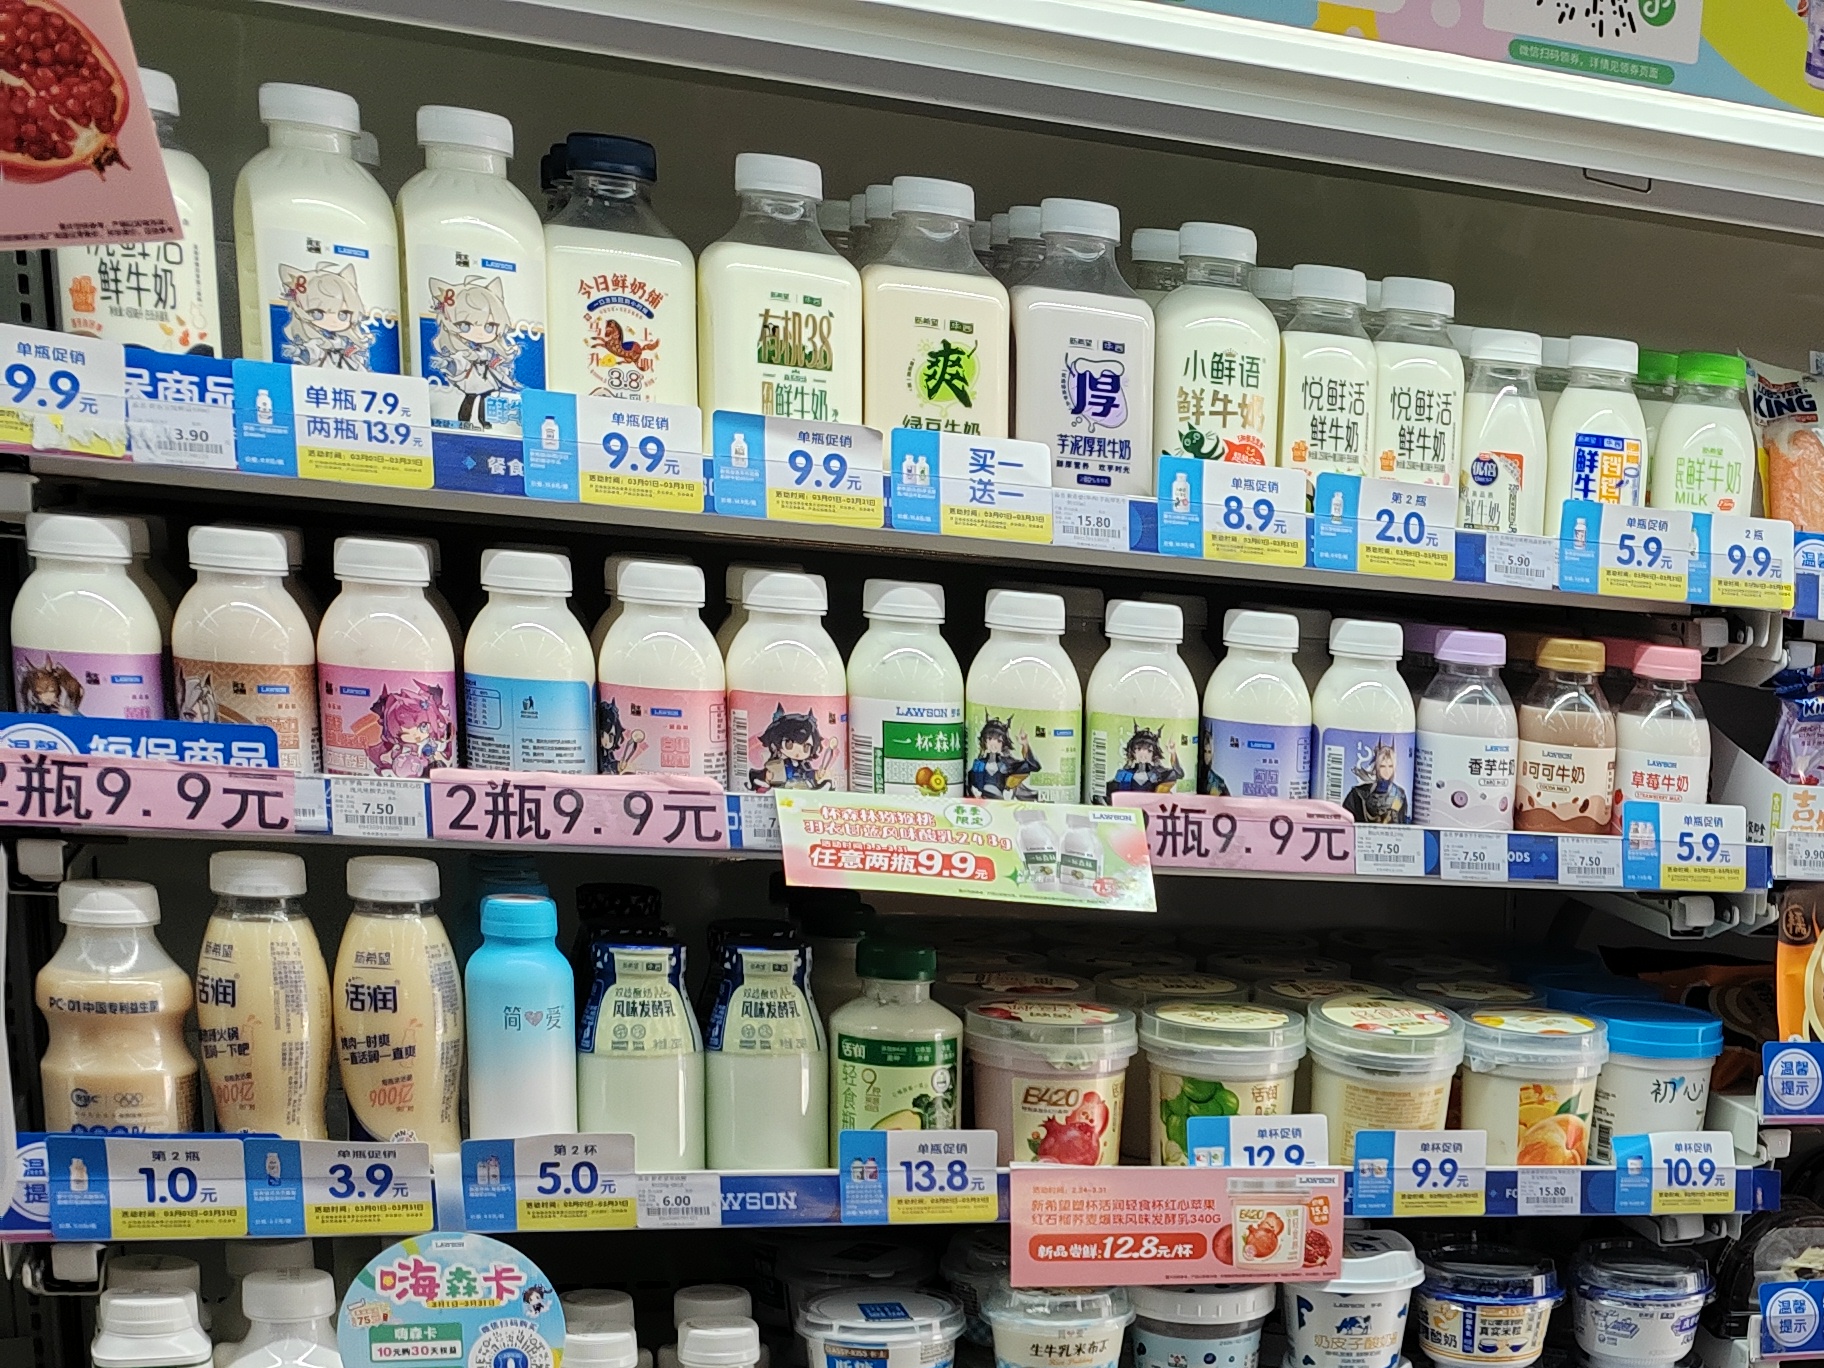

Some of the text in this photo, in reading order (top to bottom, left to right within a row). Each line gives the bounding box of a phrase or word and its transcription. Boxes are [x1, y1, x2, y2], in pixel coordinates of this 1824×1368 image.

[97, 259, 177, 310] 鲜牛奶
[578, 273, 664, 310] 今日鲜奶铺
[15, 342, 85, 366] 单瓶促销
[925, 339, 977, 408] 爽
[1183, 351, 1261, 389] 小鲜语
[5, 364, 98, 416] 9.9元
[1071, 371, 1121, 417] 厚
[1302, 375, 1366, 416] 悦鲜活
[1752, 386, 1817, 418] KING
[610, 412, 669, 431] 单瓶促销
[1177, 388, 1265, 431] 鲜牛奶
[1390, 387, 1453, 425] 悦鲜活
[797, 430, 852, 449] 单瓶促销
[1056, 434, 1131, 460] 芋泥厚乳牛奶
[1309, 415, 1359, 454] 鲜牛奶
[1397, 425, 1446, 462] 鲜牛奶
[602, 431, 679, 476] 9.9元
[969, 447, 1024, 475] 买一
[787, 449, 861, 490] 9.9元
[969, 477, 1025, 505] 送一
[1231, 477, 1279, 494] 单瓶促销
[1077, 515, 1111, 528] 15.80
[1222, 496, 1287, 534] 8.9元
[1375, 509, 1438, 547] 2.0元
[1626, 517, 1668, 533] 单瓶促销
[1745, 528, 1763, 542] 2瓶
[1616, 535, 1672, 569] 5.9元
[896, 707, 948, 718] LAWSON
[1527, 760, 1586, 783] 可可牛奶
[1631, 771, 1690, 792] 草莓牛奶
[0, 755, 289, 830] 瓶9.9元
[361, 802, 393, 816] 7.50
[447, 779, 722, 844] 2瓶9.9元
[1683, 816, 1723, 829] 单瓶促销
[810, 844, 989, 882] 任意两瓶9.9元
[1376, 843, 1400, 854] 7.50
[345, 978, 398, 1013] 活润
[741, 1001, 800, 1018] 风味发酵乳
[1023, 1087, 1079, 1106] B420
[152, 1150, 200, 1162] 第2瓶
[337, 1148, 396, 1160] 单瓶促销
[554, 1144, 597, 1156] 第2杯
[1420, 1142, 1462, 1154] 单杯促销
[138, 1167, 217, 1204] 1.0元
[328, 1165, 409, 1199] 3.9元
[537, 1161, 616, 1196] 5.0元
[901, 1161, 984, 1192] 13.8元
[1411, 1158, 1469, 1188] 9.9元
[663, 1195, 690, 1207] 6.00
[1539, 1186, 1566, 1197] 15.80
[377, 1258, 526, 1303] 嗨森卡
